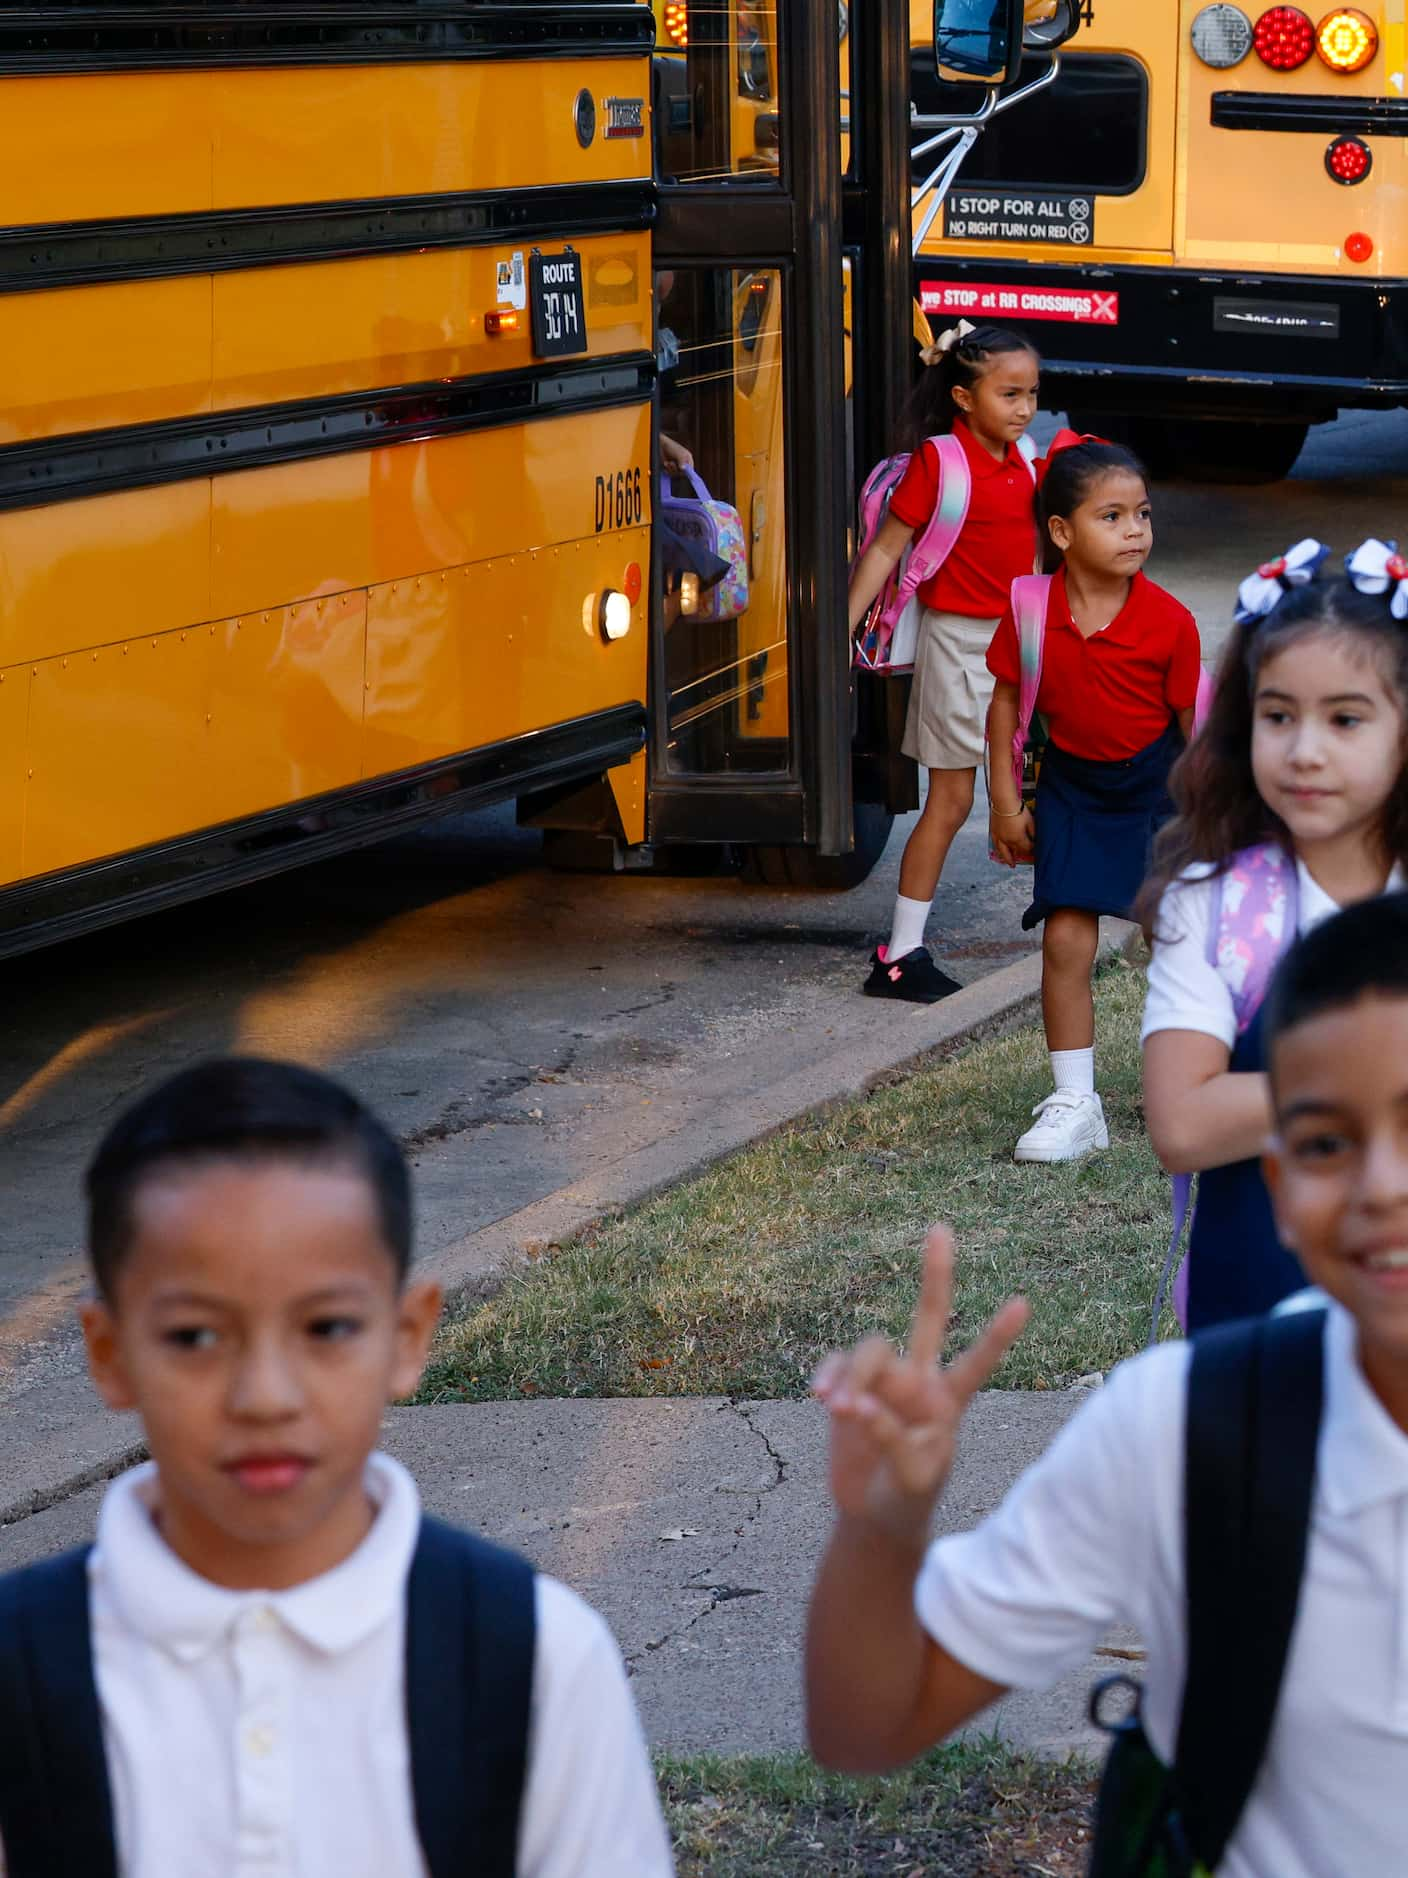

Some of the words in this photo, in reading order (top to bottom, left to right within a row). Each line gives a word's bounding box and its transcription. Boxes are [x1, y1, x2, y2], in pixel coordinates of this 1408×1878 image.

[951, 197, 956, 213] I
[959, 198, 1000, 214] STOP
[1003, 200, 1034, 216] FOR
[1037, 202, 1064, 217] ALL
[949, 221, 966, 234] NO
[967, 221, 999, 236] RIGHT
[1000, 223, 1028, 237] TURN
[1029, 225, 1047, 238] ON
[1048, 226, 1067, 239] RED
[543, 263, 575, 284] ROUTE
[943, 289, 978, 307] STOP
[981, 291, 996, 308] at
[999, 292, 1019, 309] RR
[1021, 293, 1092, 313] CROSSINGS
[595, 467, 641, 533] D1666
